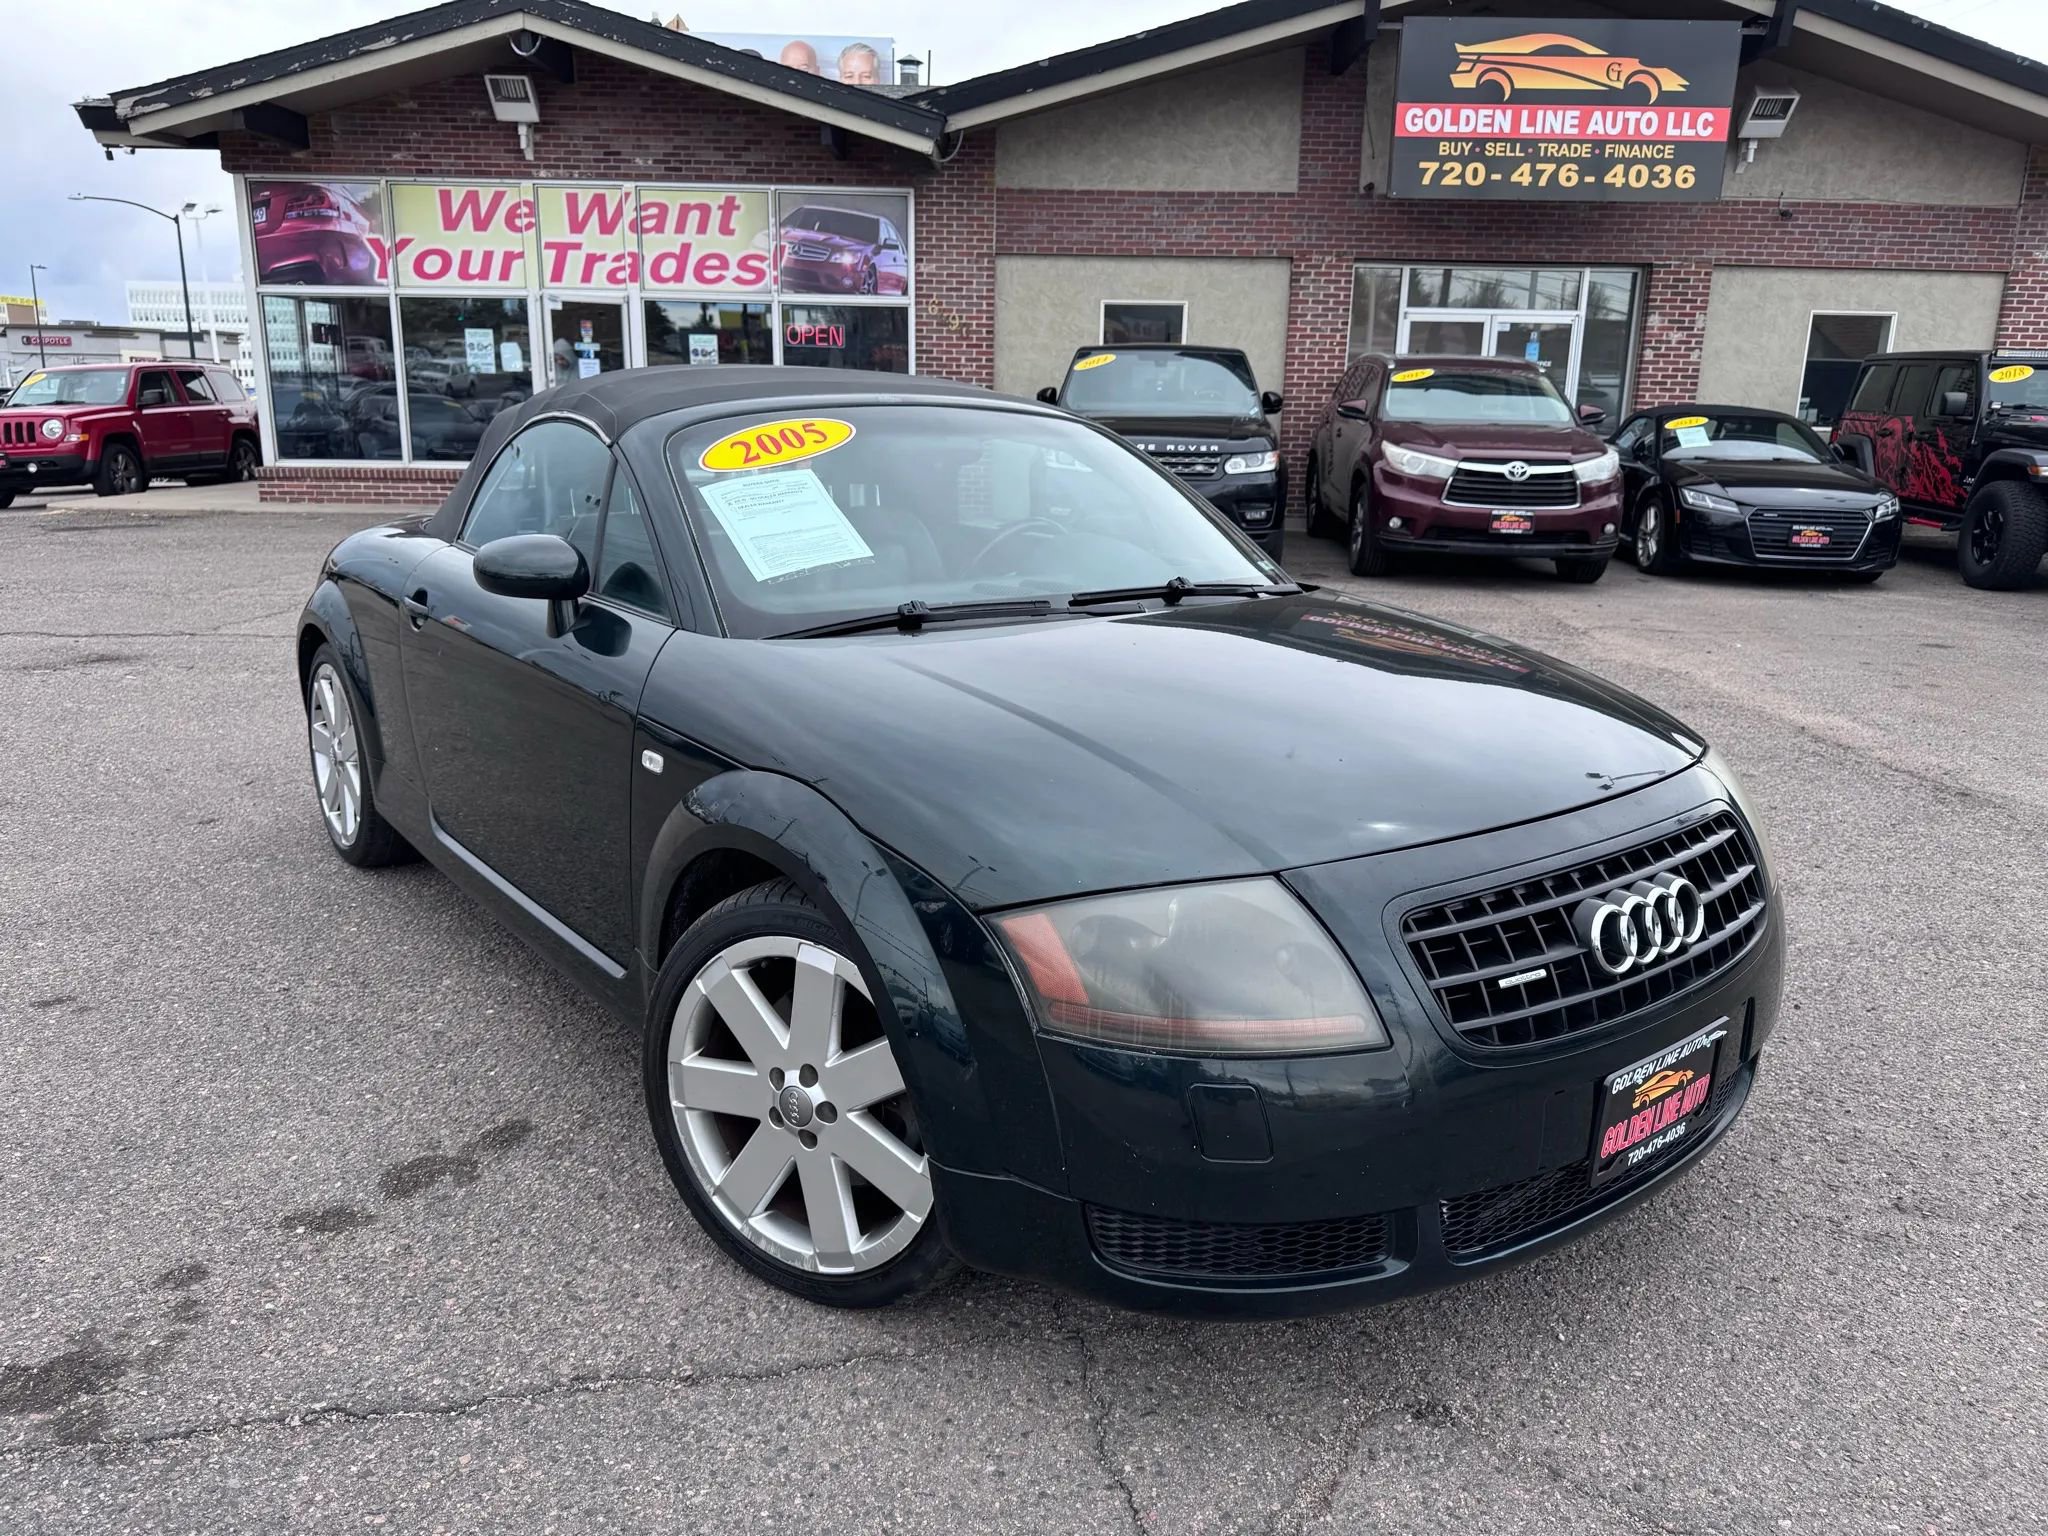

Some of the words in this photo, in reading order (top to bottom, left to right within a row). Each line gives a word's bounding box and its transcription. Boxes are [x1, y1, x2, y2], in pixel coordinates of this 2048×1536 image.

[1606, 62, 1623, 82] G
[1404, 107, 1513, 134] GOLDEN
[1519, 109, 1581, 136] LINE
[1586, 110, 1659, 137] AUTO
[1665, 111, 1715, 138] LLC
[1438, 141, 1473, 157] BUY
[1484, 142, 1526, 157] SELL
[1538, 143, 1592, 158] TRADE
[1604, 144, 1676, 159] FINANCE
[438, 188, 536, 234] We
[565, 191, 742, 237] Want
[366, 237, 526, 282] Your
[543, 241, 787, 287] Trades!
[31, 336, 68, 345] CHIPOTLE
[785, 324, 845, 347] OPEN
[1998, 366, 2026, 381] 2018
[729, 422, 828, 465] 2005
[1166, 444, 1219, 452] ROVER
[1656, 1046, 1681, 1072] LINE
[1600, 1104, 1656, 1160] GOLDEN
[1652, 1090, 1683, 1133] LINE
[1680, 1072, 1711, 1118] AUTO
[1626, 1121, 1687, 1168] 720-476-4036
